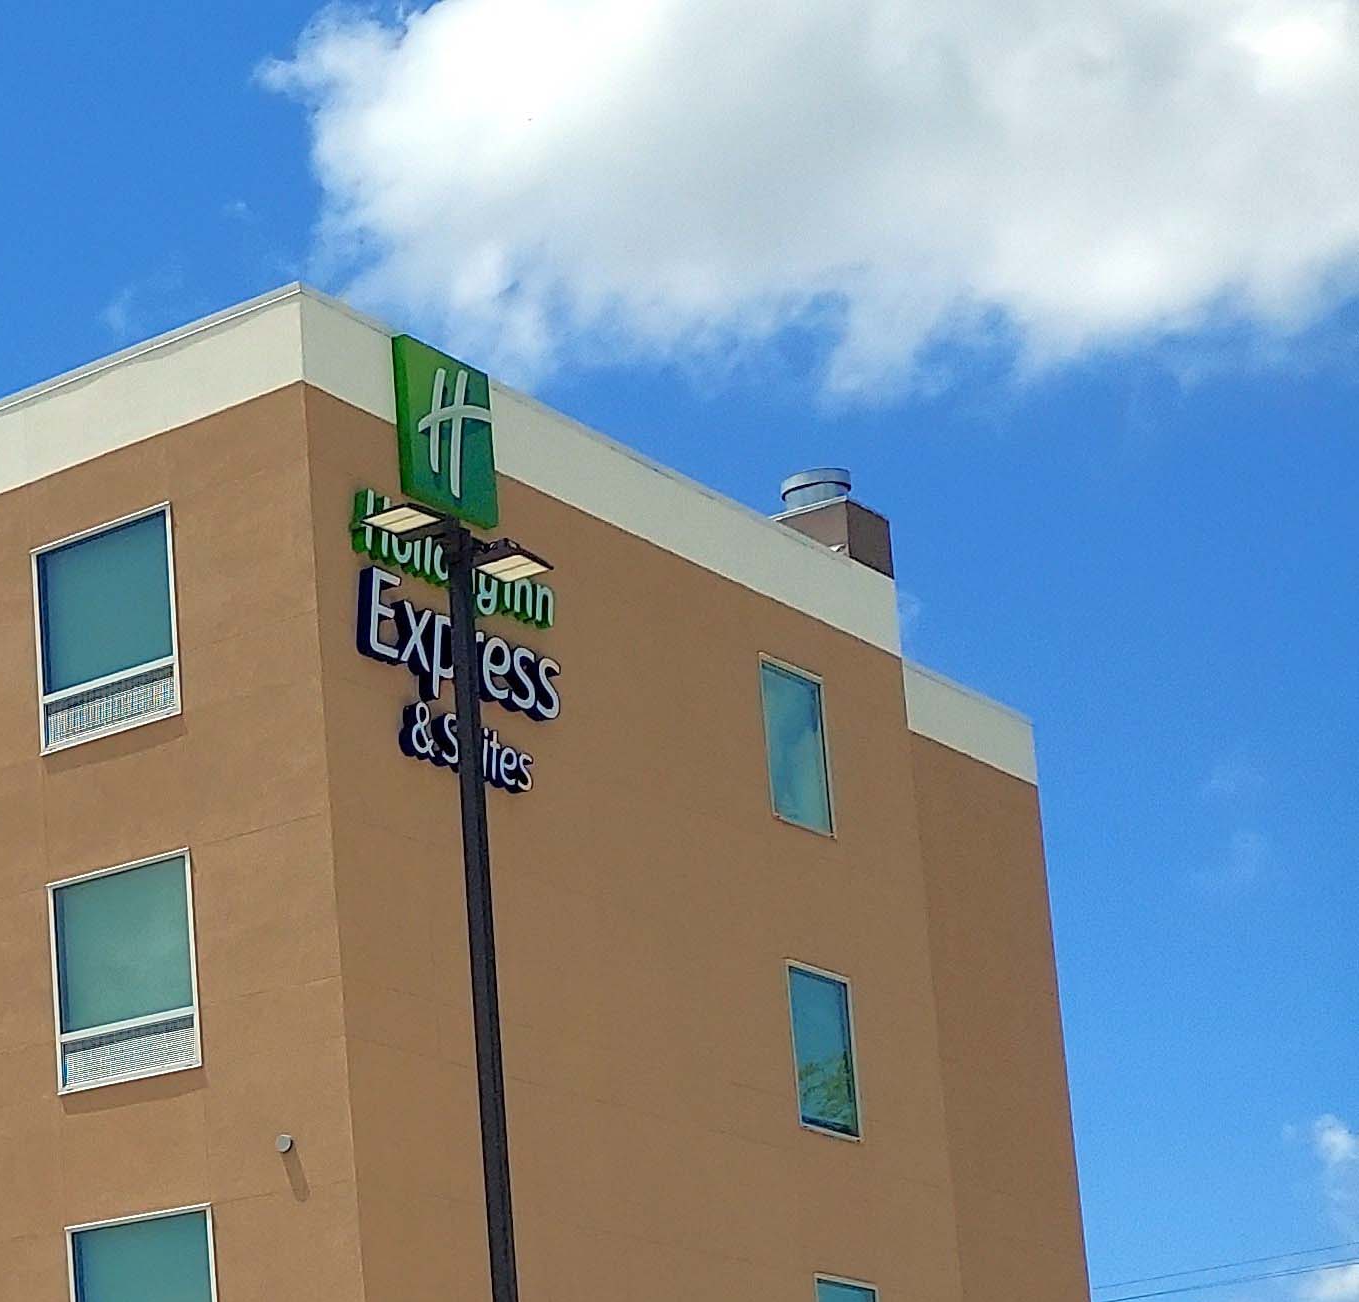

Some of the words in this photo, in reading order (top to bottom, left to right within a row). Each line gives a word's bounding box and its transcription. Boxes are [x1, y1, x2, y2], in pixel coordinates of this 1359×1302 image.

[361, 488, 498, 616] Holiy
[369, 566, 561, 719] Expess
[411, 701, 436, 757] &
[443, 713, 533, 791] Sites
